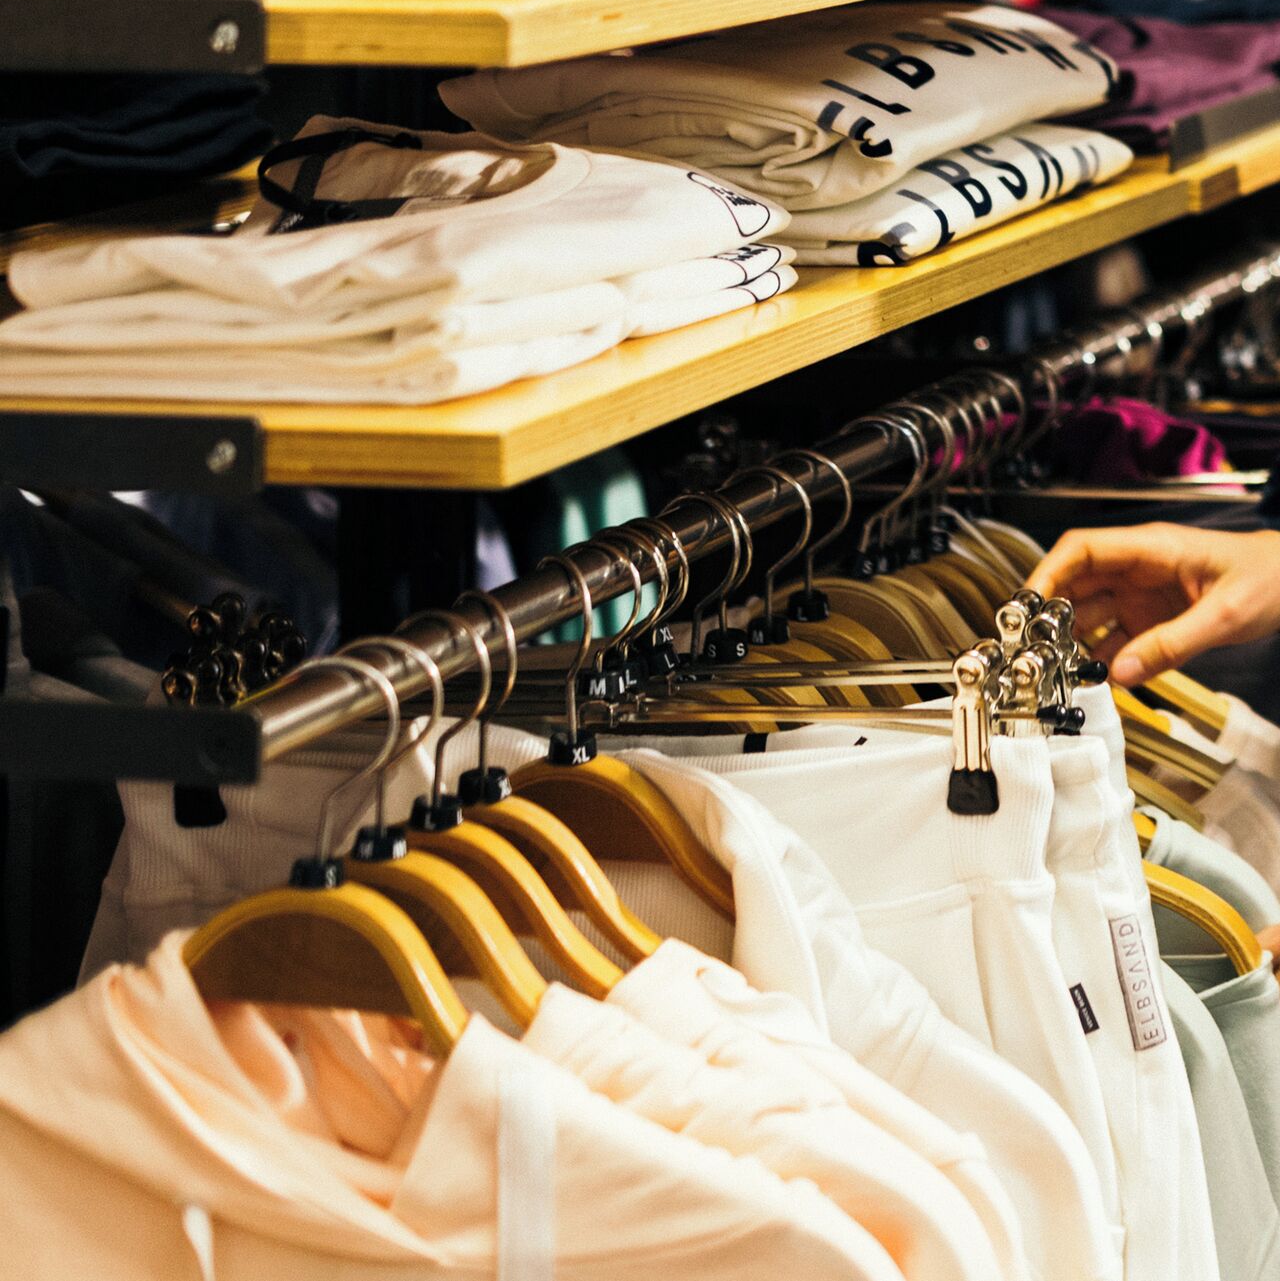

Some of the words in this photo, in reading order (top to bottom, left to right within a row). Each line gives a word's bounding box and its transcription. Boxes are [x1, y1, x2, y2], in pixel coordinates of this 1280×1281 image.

[660, 626, 674, 642] XL
[736, 642, 746, 658] S
[663, 653, 675, 669] L
[589, 677, 607, 697] M
[572, 746, 590, 764] XL
[1119, 923, 1159, 1040] ELBSAND
